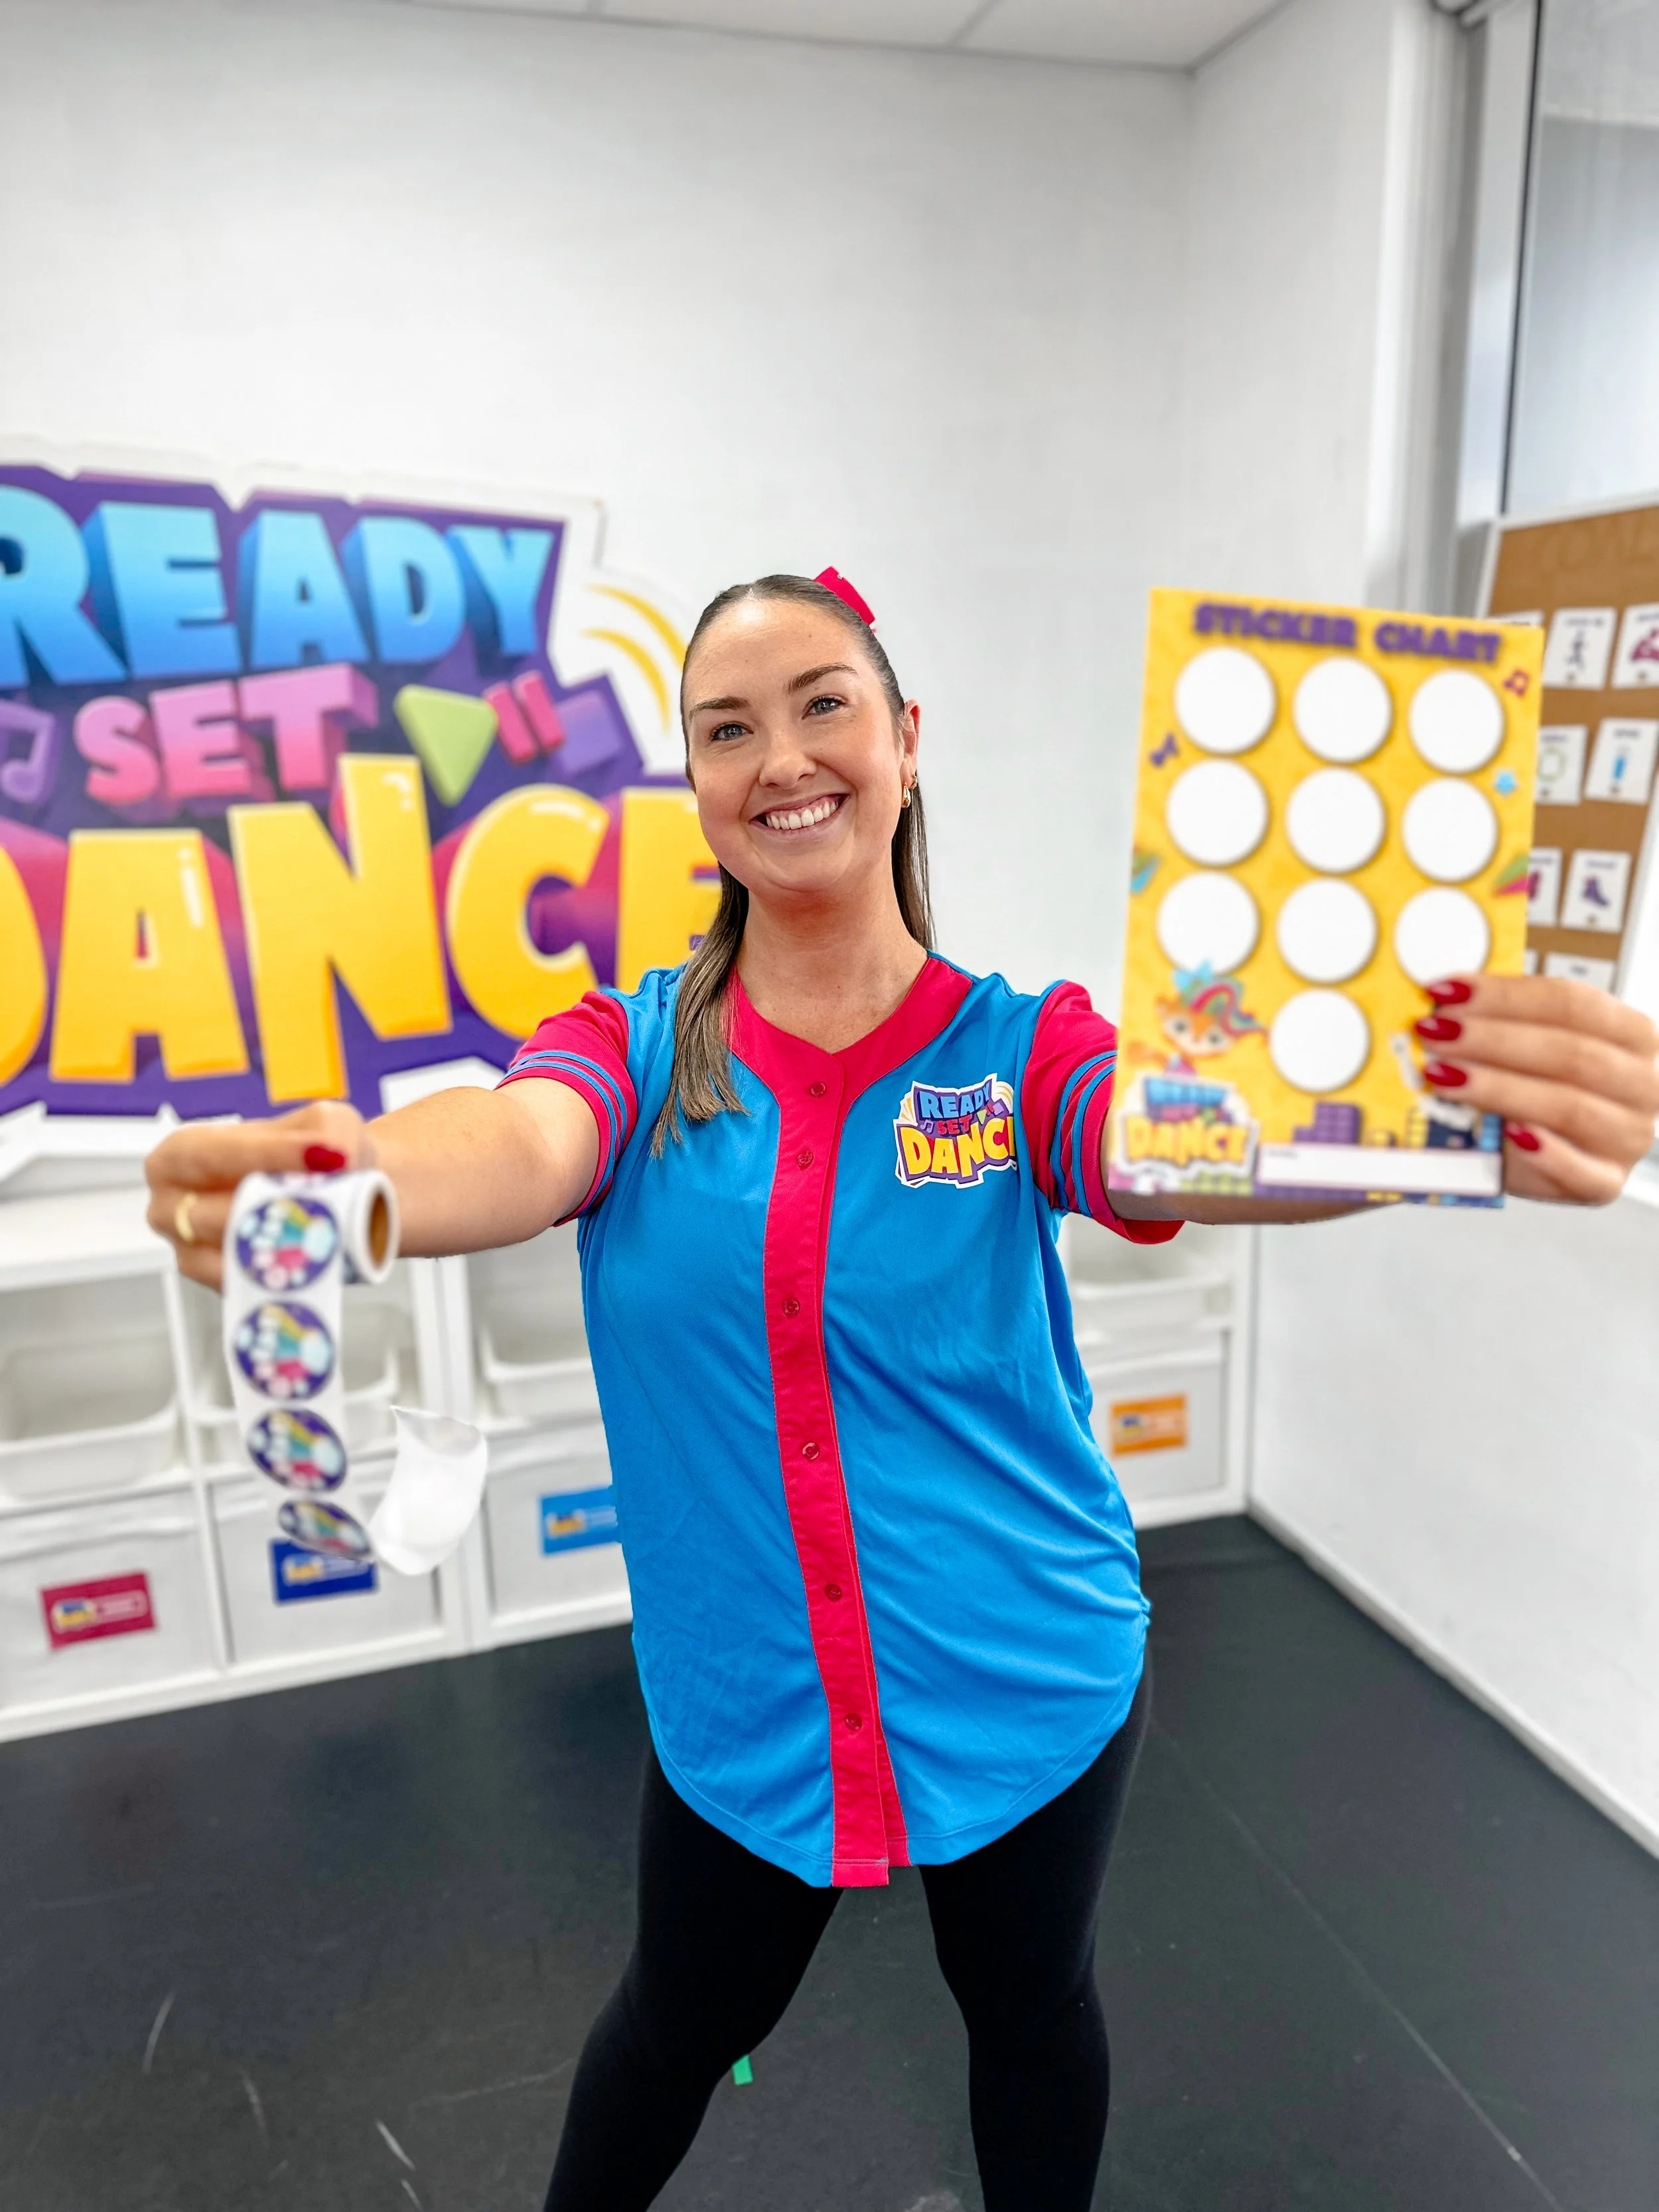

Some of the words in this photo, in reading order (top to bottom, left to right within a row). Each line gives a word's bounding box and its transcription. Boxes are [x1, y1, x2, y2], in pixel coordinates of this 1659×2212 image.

[0, 484, 555, 686] READY
[1194, 602, 1356, 649] STICKER
[1374, 620, 1502, 664] CHART
[74, 664, 362, 804] SET
[0, 754, 721, 1106] ANCE
[919, 1083, 991, 1119] READY
[935, 1114, 973, 1135] SET
